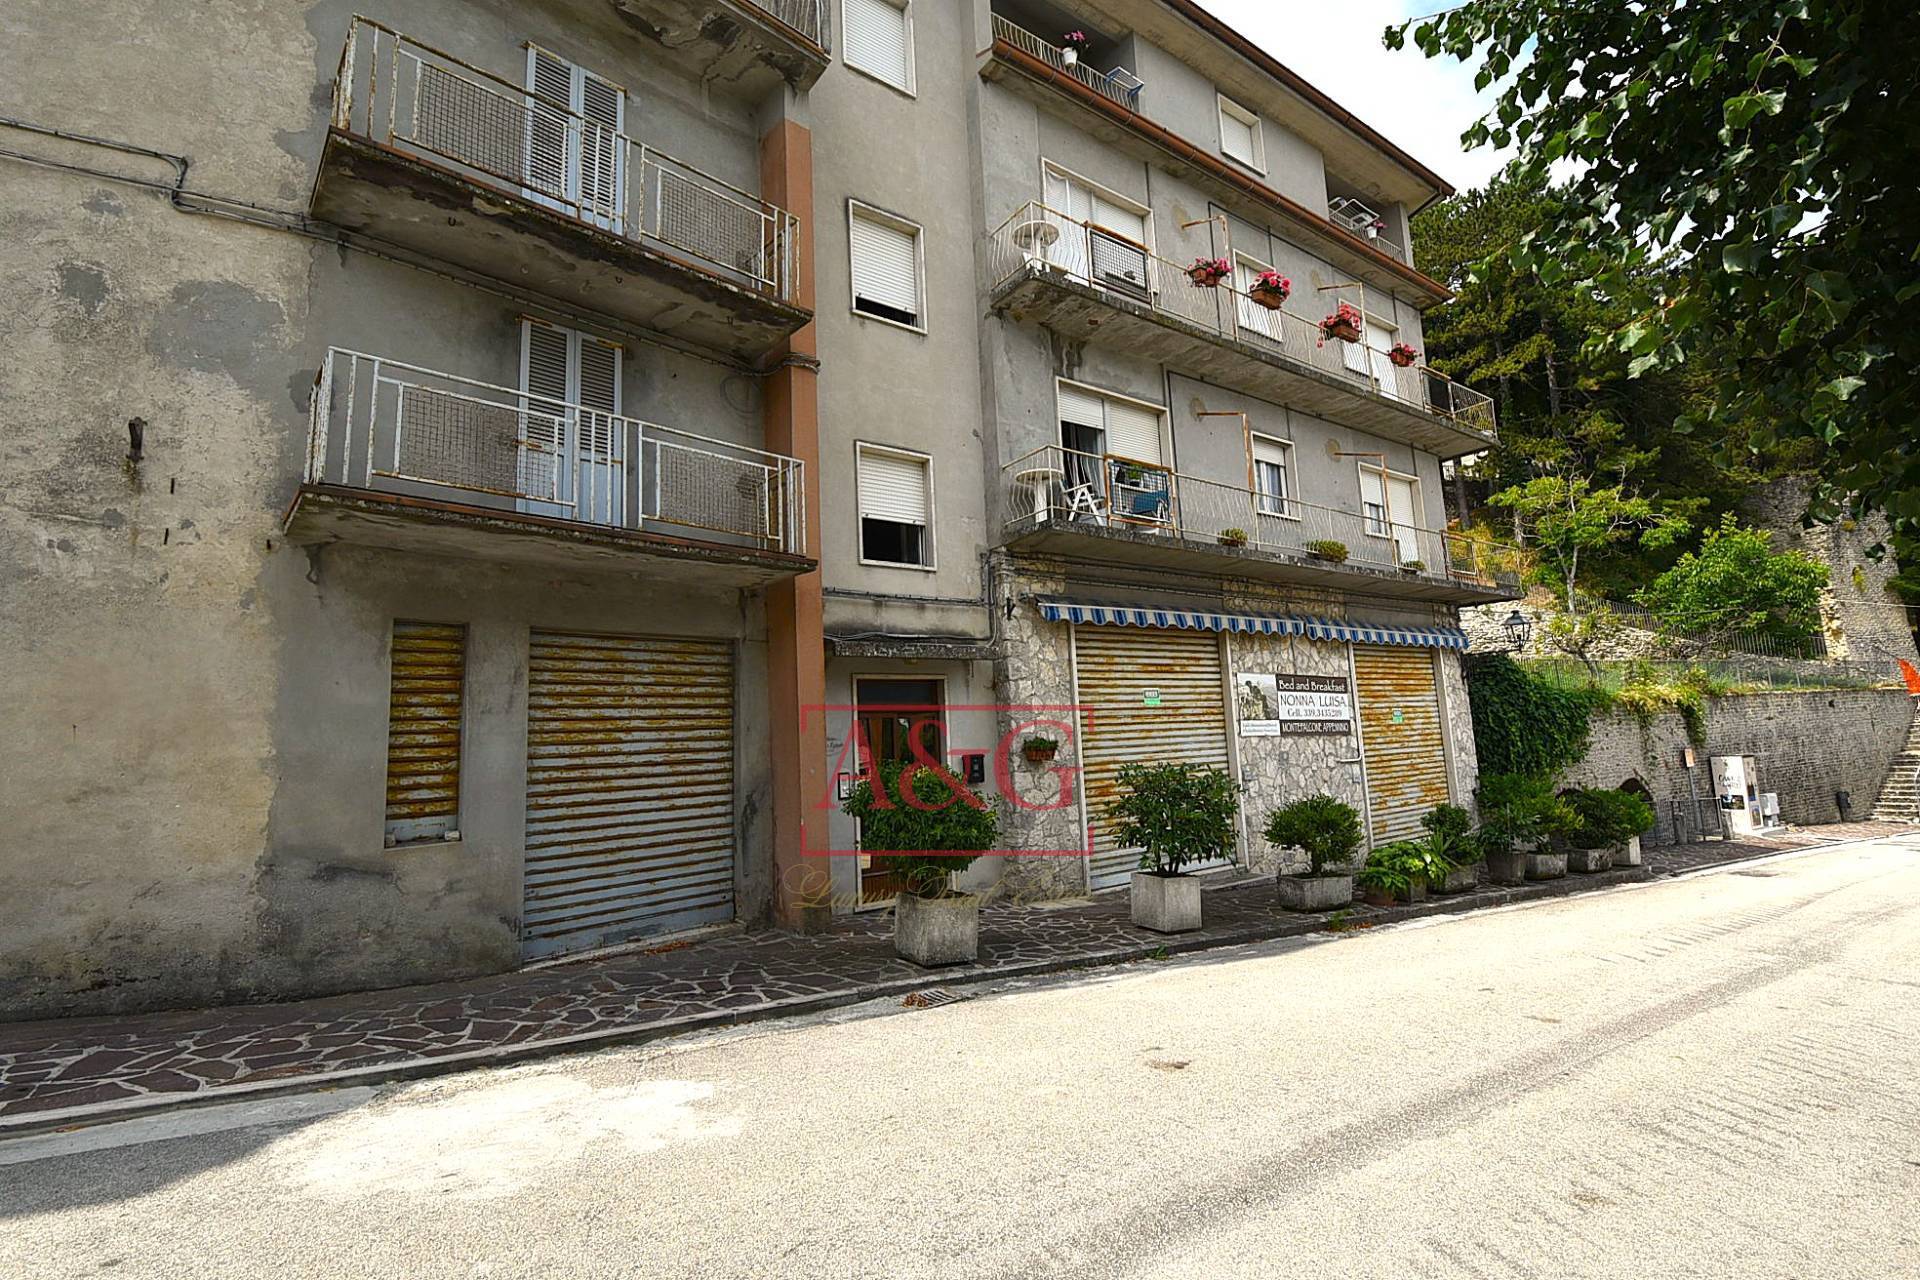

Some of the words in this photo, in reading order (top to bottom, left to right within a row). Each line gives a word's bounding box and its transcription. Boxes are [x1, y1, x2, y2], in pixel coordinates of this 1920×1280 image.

[1279, 677, 1295, 690] Bed
[1295, 678, 1310, 691] and
[1310, 679, 1346, 692] Breakfast
[1280, 693, 1316, 708] NONNA
[1318, 695, 1348, 708] LUISA
[1281, 721, 1323, 733] MONTEFALCONE
